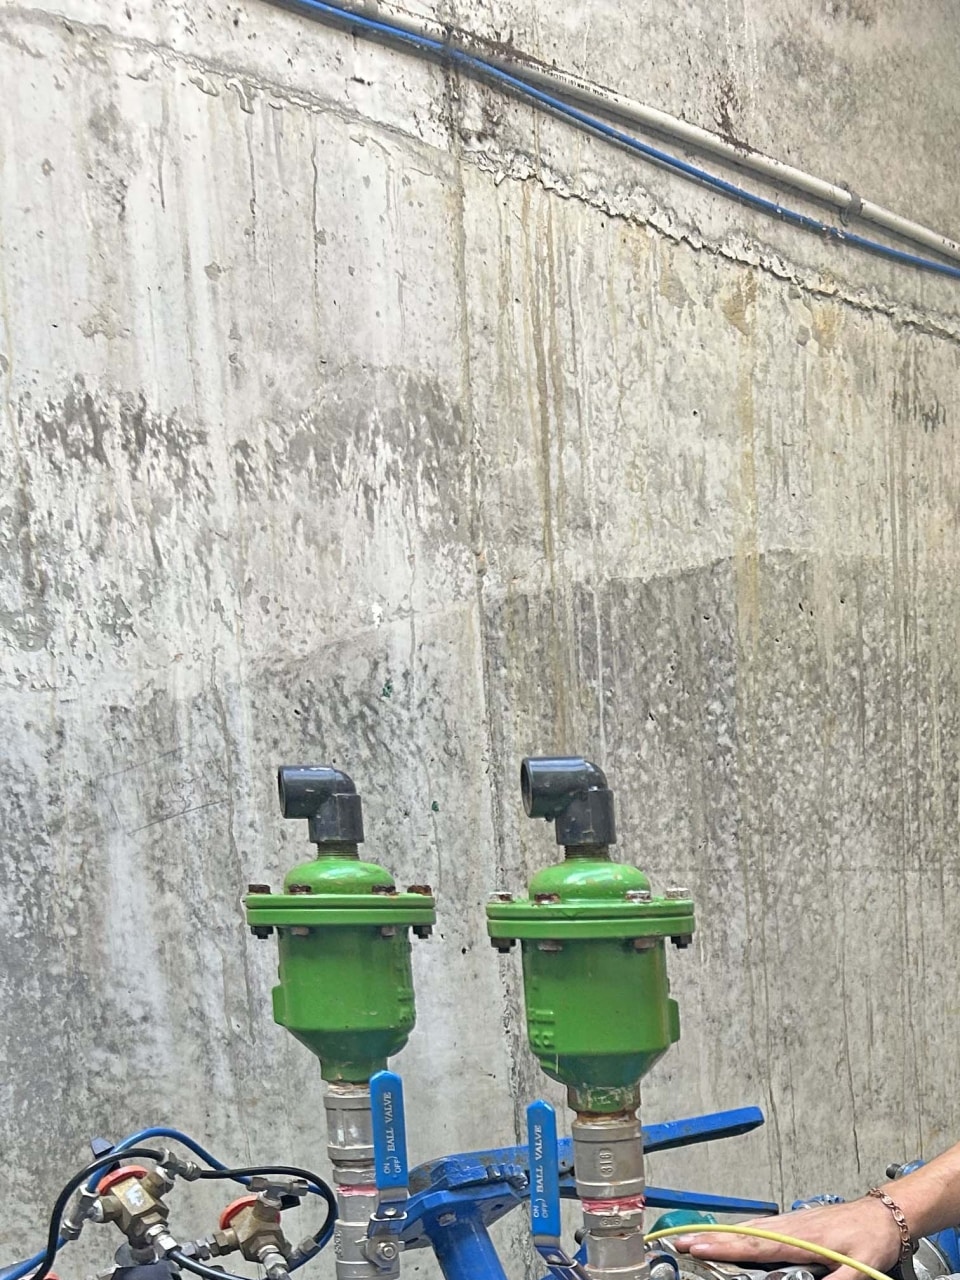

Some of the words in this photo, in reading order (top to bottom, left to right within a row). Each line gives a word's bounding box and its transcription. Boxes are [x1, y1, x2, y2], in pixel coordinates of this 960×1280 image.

[383, 1091, 394, 1125] VALVE
[386, 1128, 396, 1152] BALL
[534, 1125, 543, 1161] VALVE
[384, 1163, 391, 1174] ON
[394, 1160, 402, 1173] OFF
[536, 1165, 545, 1193] BALL
[533, 1206, 540, 1218] ON
